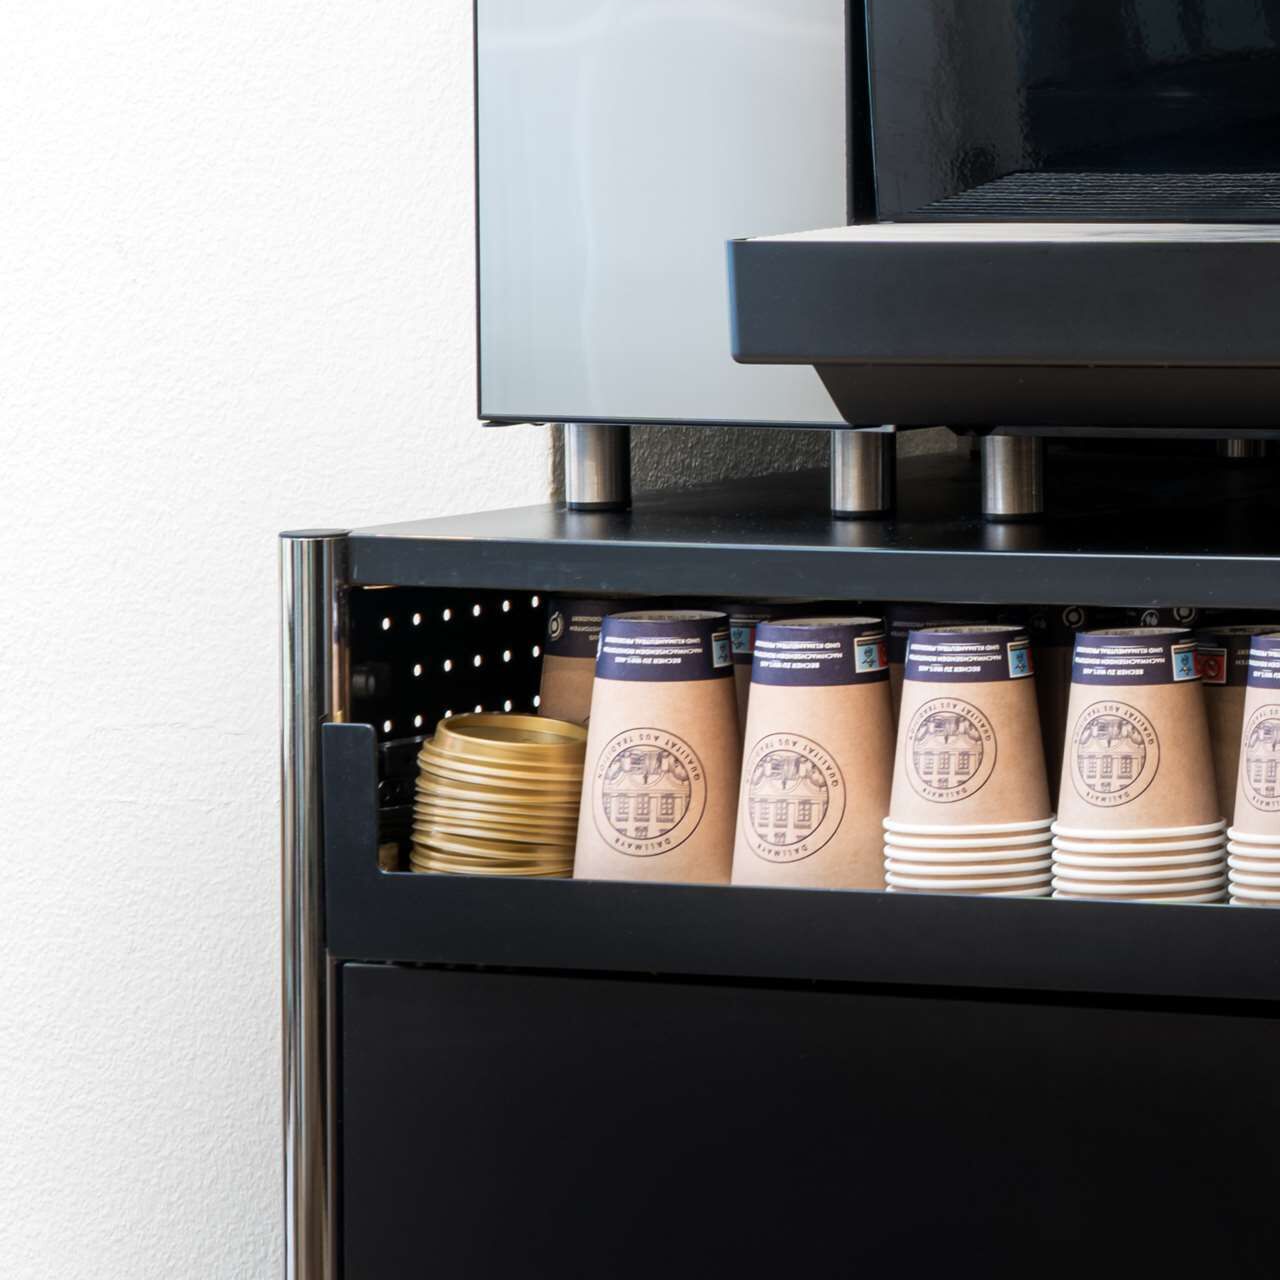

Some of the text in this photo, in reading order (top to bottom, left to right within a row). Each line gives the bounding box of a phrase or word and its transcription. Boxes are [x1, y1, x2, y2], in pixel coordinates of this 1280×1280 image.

[639, 734, 660, 742] AUS
[778, 739, 798, 747] AUS
[614, 837, 672, 851] DALLMAYR
[757, 844, 809, 857] DALLMAYR
